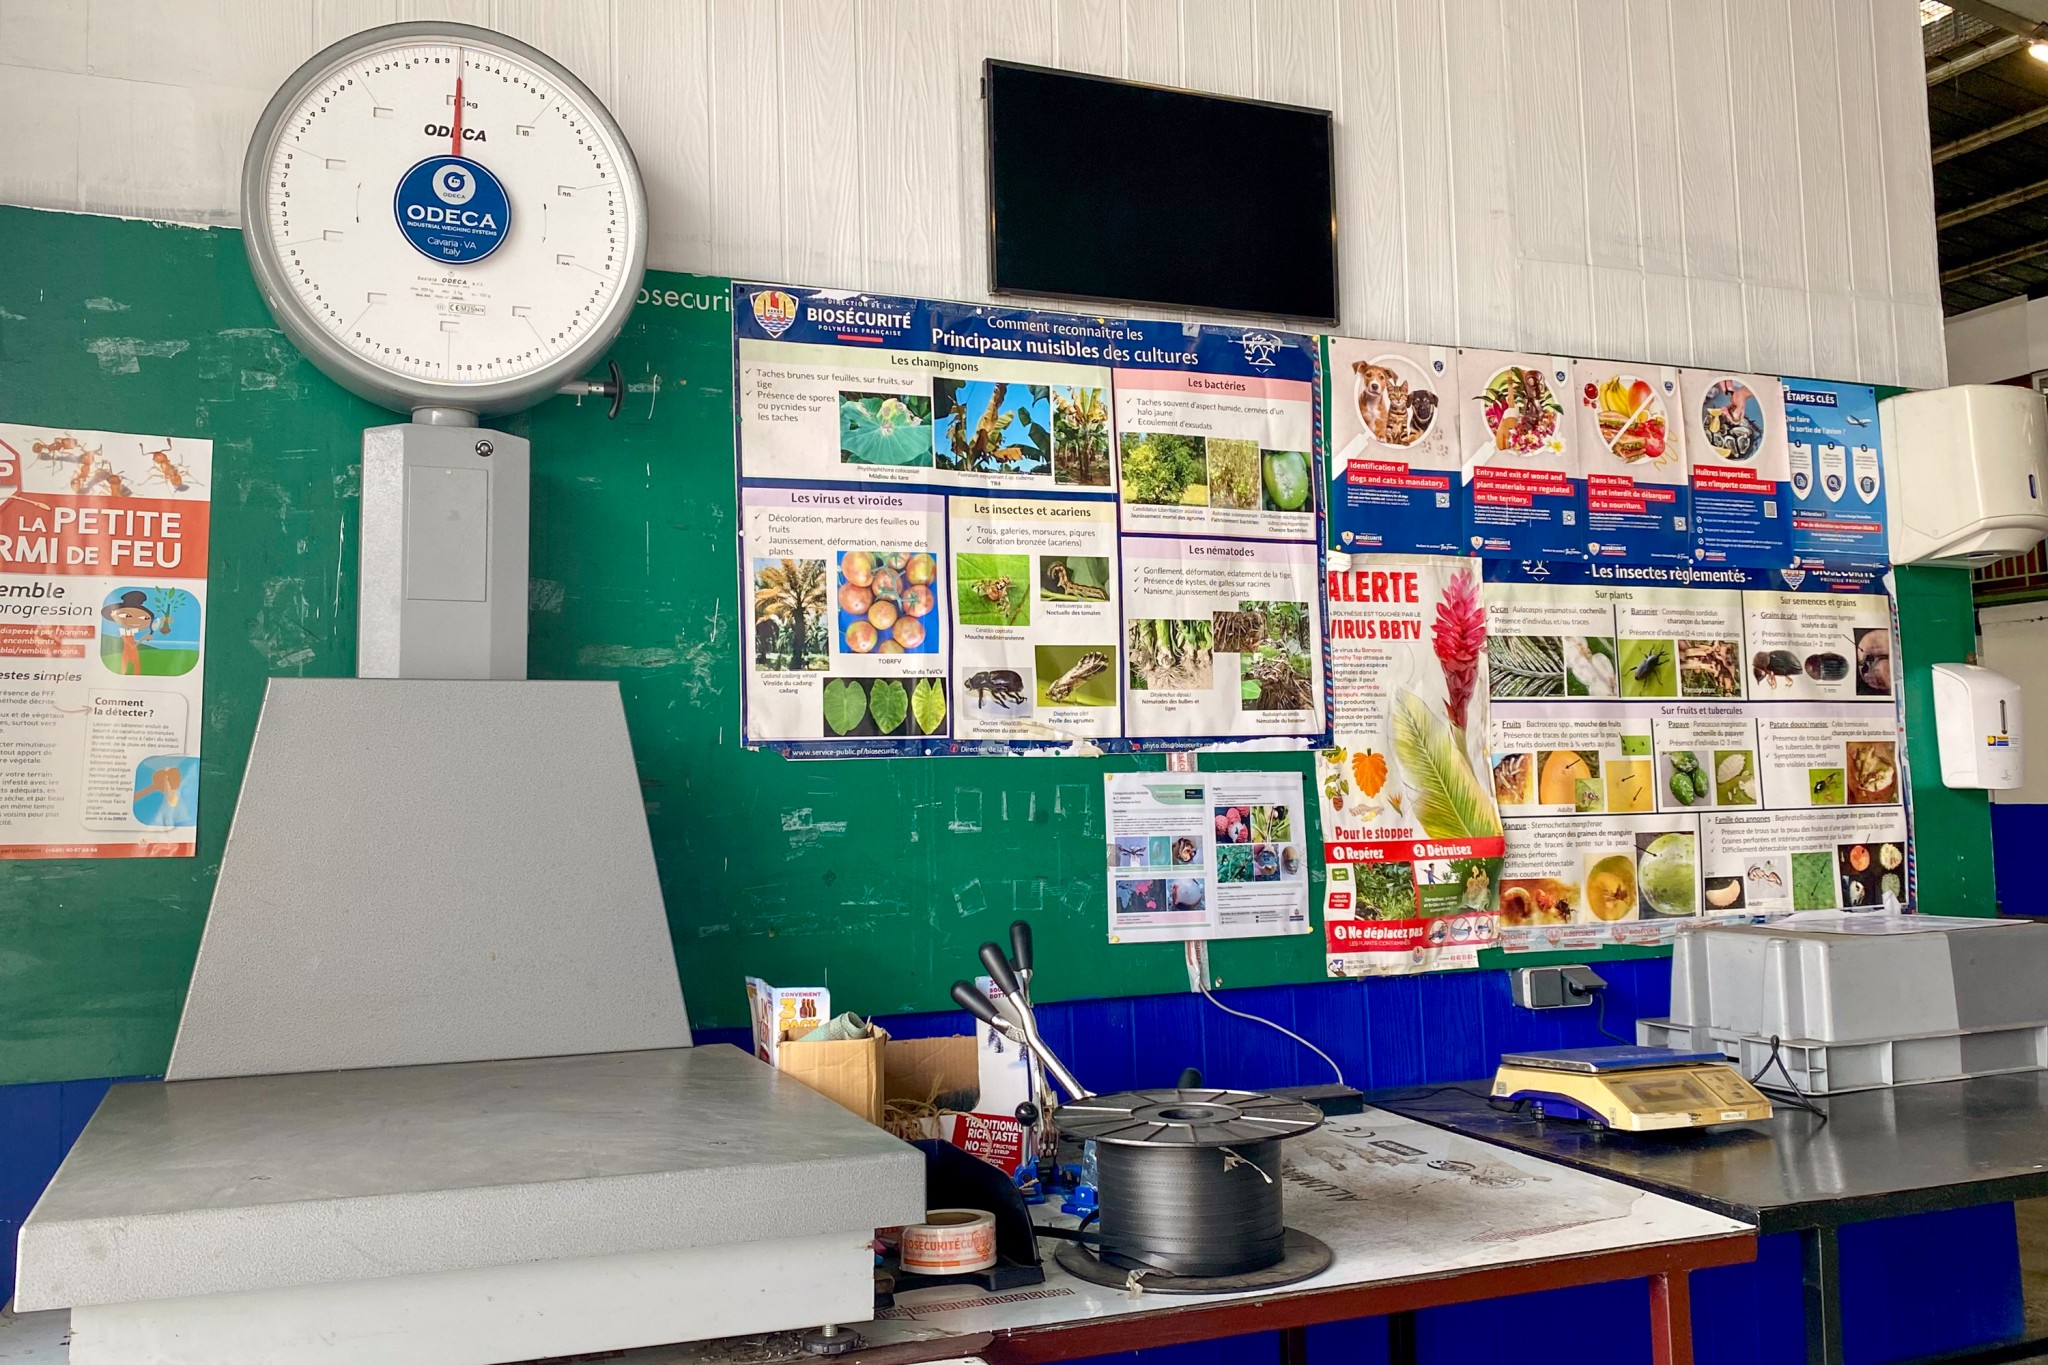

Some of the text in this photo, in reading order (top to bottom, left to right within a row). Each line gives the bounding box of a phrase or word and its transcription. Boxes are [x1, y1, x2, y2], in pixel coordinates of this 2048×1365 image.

[466, 100, 478, 109] kg
[407, 204, 497, 229] ODECA
[407, 221, 440, 229] INDUSTRIAL
[442, 225, 471, 233] WEIGHING
[427, 237, 476, 249] Cavaria VA
[443, 247, 460, 257] Italy
[828, 298, 866, 308] DIRECTION
[807, 306, 911, 329] BIOSÉCURITÉ
[818, 324, 902, 336] POLYNÉSIE FRANÇAISE
[987, 316, 1143, 340] Comment reconnaître les
[932, 328, 1199, 365] Principaux nuisibles des cultures
[891, 355, 979, 372] Les champignons
[756, 369, 784, 379] Taches
[787, 370, 814, 380] brunes
[832, 373, 862, 384] feuilles,
[878, 376, 900, 386] fruits,
[902, 378, 913, 386] sur
[1188, 378, 1246, 391] Les bactéries
[1786, 391, 1835, 404] ÉTAPES CLÉS
[1138, 418, 1212, 429] Ecoulement d'exsudats
[1350, 462, 1405, 472] Identification of
[1476, 469, 1494, 479] Entry
[1495, 470, 1508, 478] and
[1509, 471, 1520, 479] exit
[1522, 471, 1529, 479] of
[1550, 473, 1562, 481] and
[1696, 469, 1751, 479] Huîtres importées
[1350, 475, 1367, 485] dogs
[1368, 476, 1380, 484] and
[1382, 477, 1396, 485] cats
[1405, 478, 1445, 488] mandatory.
[1618, 478, 1631, 486] îles,
[1696, 482, 1707, 490] pas
[1708, 481, 1737, 490] n'importe
[1476, 481, 1493, 491] plant
[1495, 483, 1525, 492] materials
[1539, 485, 1570, 495] regulated
[791, 493, 903, 506] Les virus et viroïdes
[1489, 494, 1498, 502] the
[1499, 495, 1529, 505] territory.
[974, 504, 1091, 517] Les insectes et acariens
[1608, 502, 1643, 510] nourriture.
[19, 507, 182, 538] LA PETITE
[768, 514, 824, 524] Décoloration,
[826, 516, 862, 525] marbrure
[865, 517, 878, 525] des
[880, 517, 907, 526] feuilles
[977, 526, 1095, 537] Trous, galeries, morsures, piqures
[768, 536, 825, 546] Jaunissement,
[827, 538, 879, 547] déformation,
[914, 540, 928, 548] des
[977, 537, 1082, 547] Coloration bronzée (acariens)
[67, 547, 98, 565] DE
[111, 540, 182, 568] FEU
[1189, 545, 1254, 557] Les nématodes
[1592, 565, 1745, 585] Les insectes règlementés
[1329, 572, 1419, 603] ALERTE
[1595, 590, 1633, 600] Sur plants
[1780, 596, 1857, 608] Sur semences et grains
[1631, 608, 1658, 616] Bananier
[1, 627, 38, 637] dispersée
[40, 629, 53, 637] par
[1331, 620, 1421, 640] VIRUS BBTV
[3, 637, 56, 645] encombrants,
[33, 671, 82, 683] simples
[95, 697, 144, 707] Comment
[94, 707, 147, 718] la détecter
[1677, 706, 1698, 715] fruits
[1699, 707, 1707, 715] et
[1708, 706, 1742, 715] tubercules
[1770, 721, 1789, 729] Patate
[1336, 827, 1413, 840] Pour le stopper
[1347, 848, 1384, 861] Repérez
[1427, 845, 1472, 857] Détruisez
[1349, 926, 1423, 940] Ne déplacez pas
[779, 998, 796, 1019] 3
[966, 1118, 1022, 1133] TRADITIONAL
[991, 1131, 1019, 1143] TASTE
[965, 1140, 979, 1151] NO
